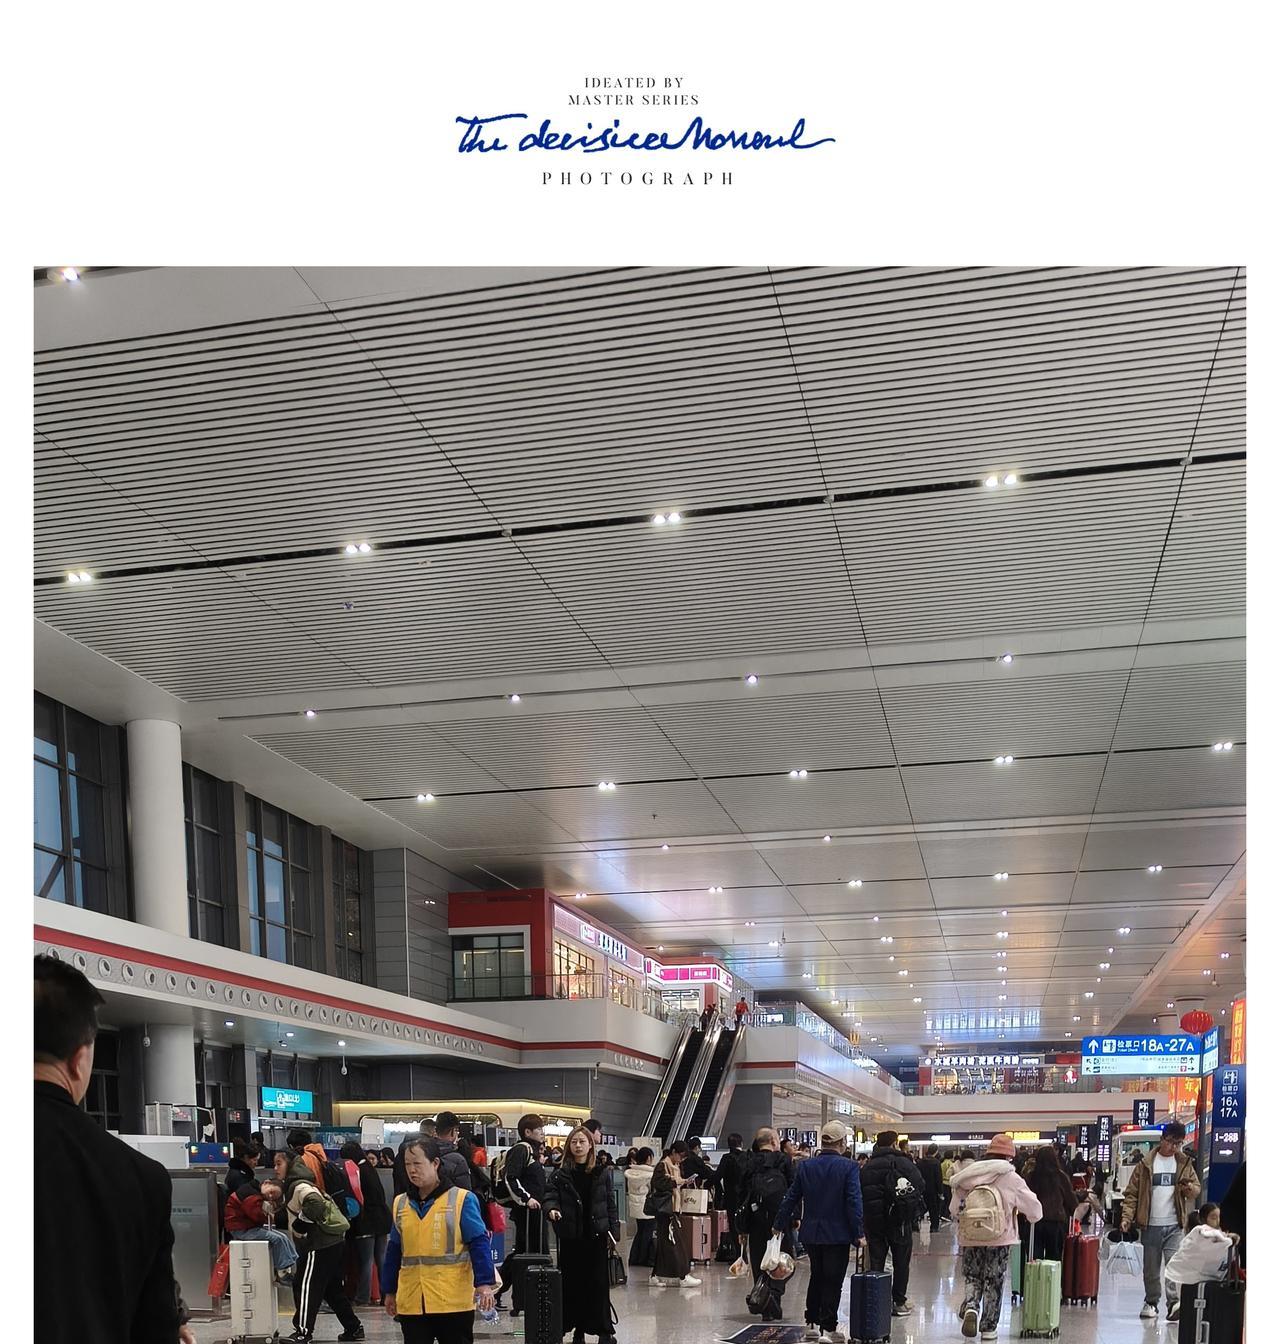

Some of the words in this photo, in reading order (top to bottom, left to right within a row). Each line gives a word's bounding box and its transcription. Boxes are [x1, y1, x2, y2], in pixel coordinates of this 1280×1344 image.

[1141, 1038, 1195, 1052] 18A-27A
[1220, 1096, 1238, 1107] 16A
[1220, 1108, 1238, 1118] 17A
